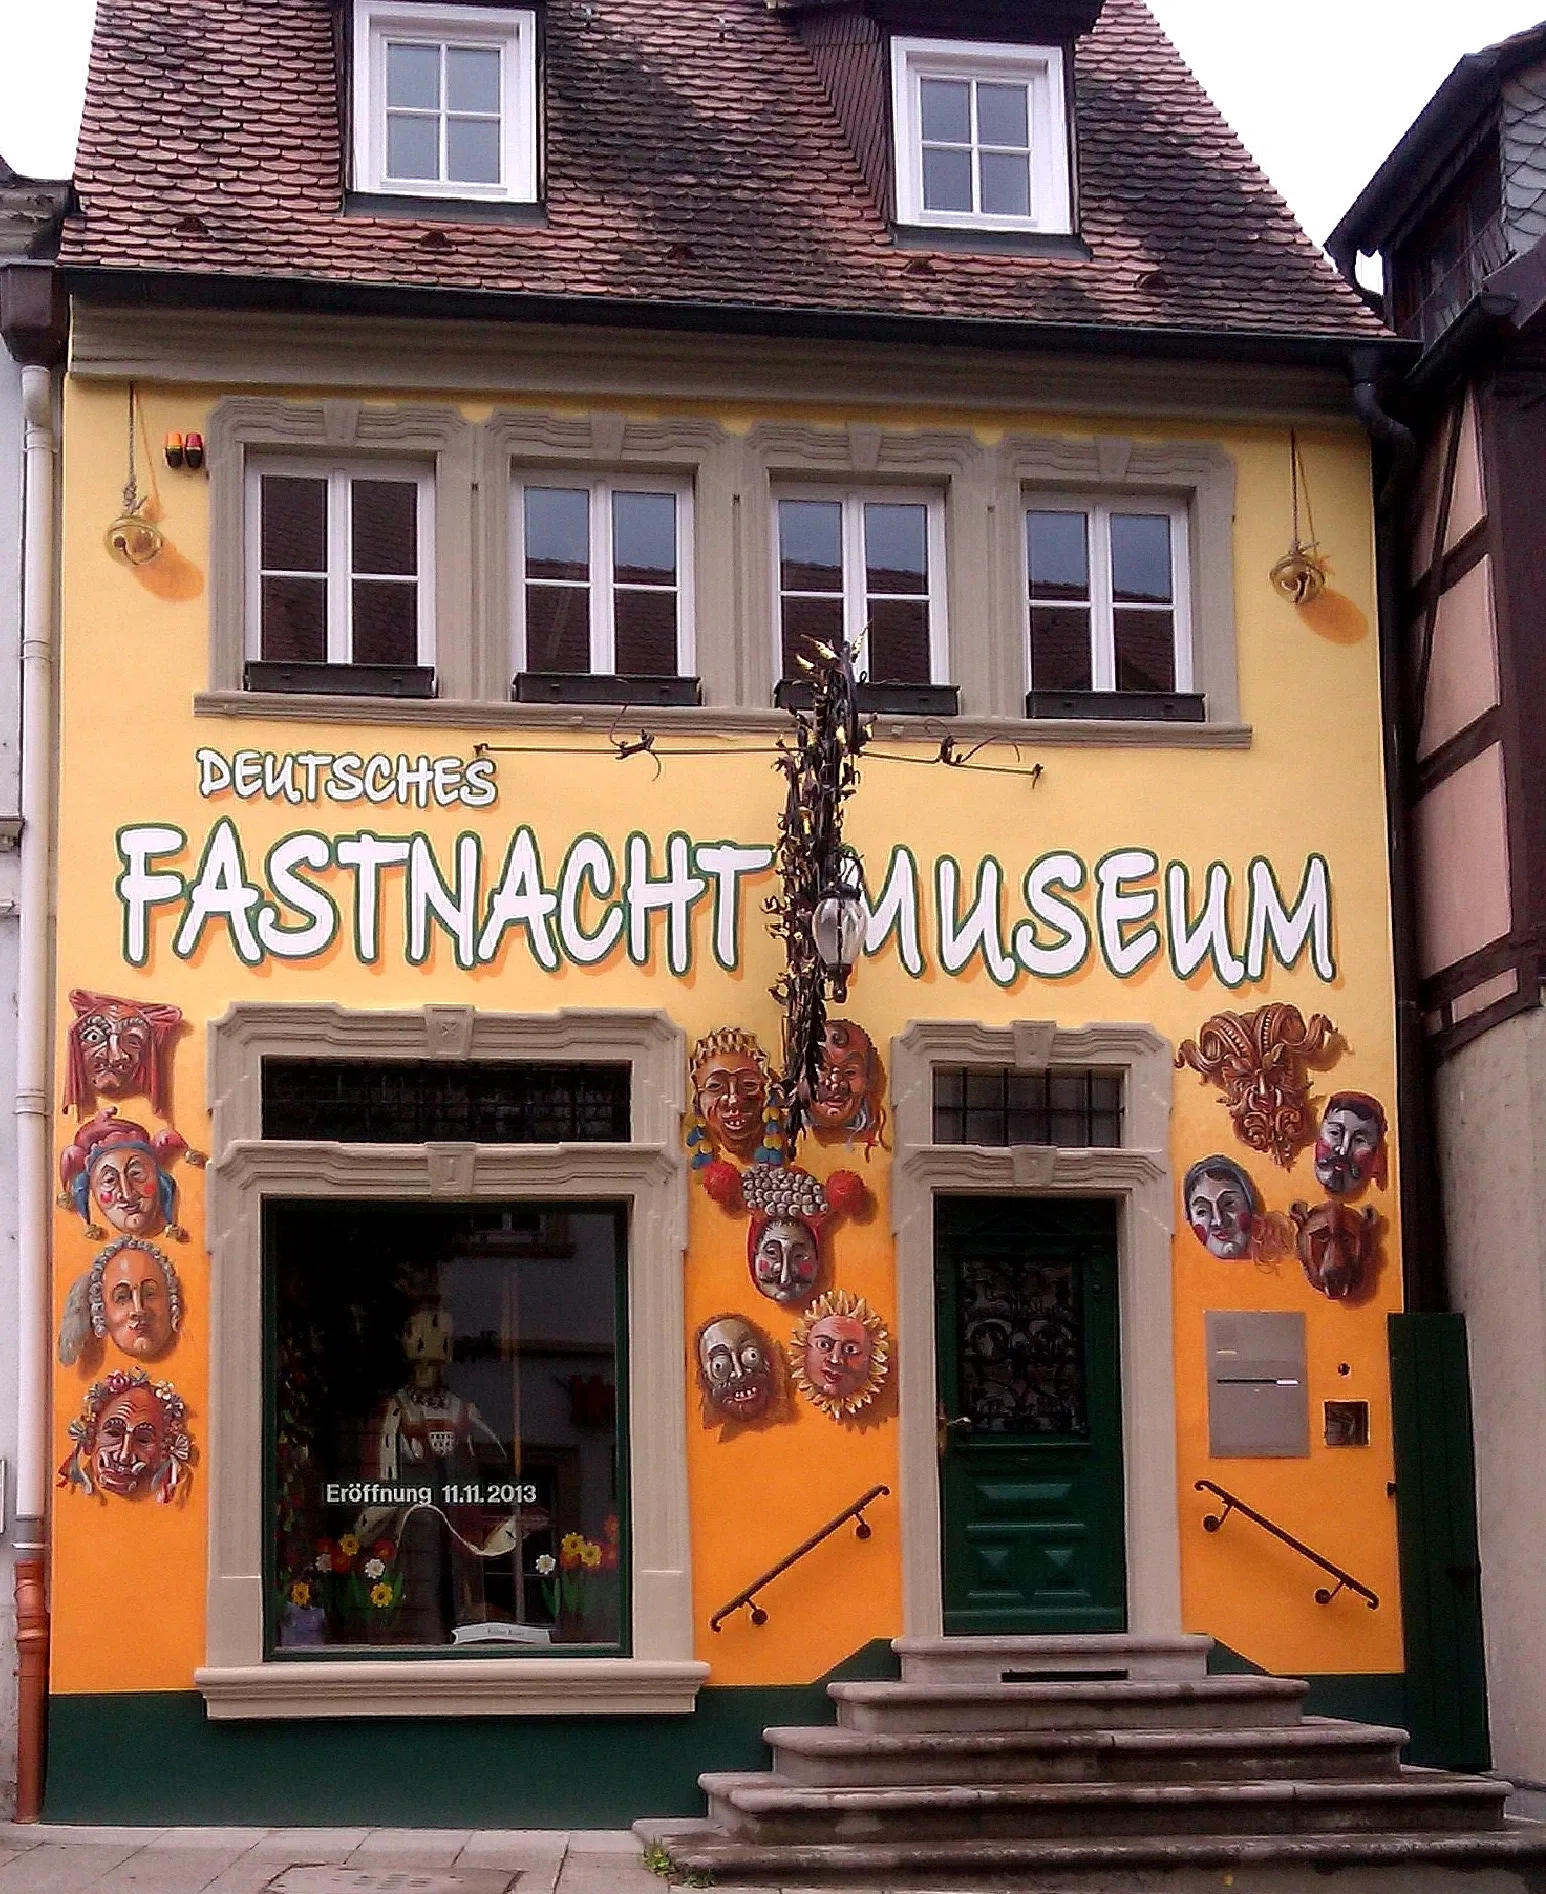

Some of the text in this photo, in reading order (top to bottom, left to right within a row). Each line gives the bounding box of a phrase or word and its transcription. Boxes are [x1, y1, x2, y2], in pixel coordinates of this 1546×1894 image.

[197, 748, 497, 807] DEUTSCHES
[116, 817, 1336, 985] FASTNACHT MUSEUM
[326, 1484, 537, 1504] Eröffnung 11.11.2013
